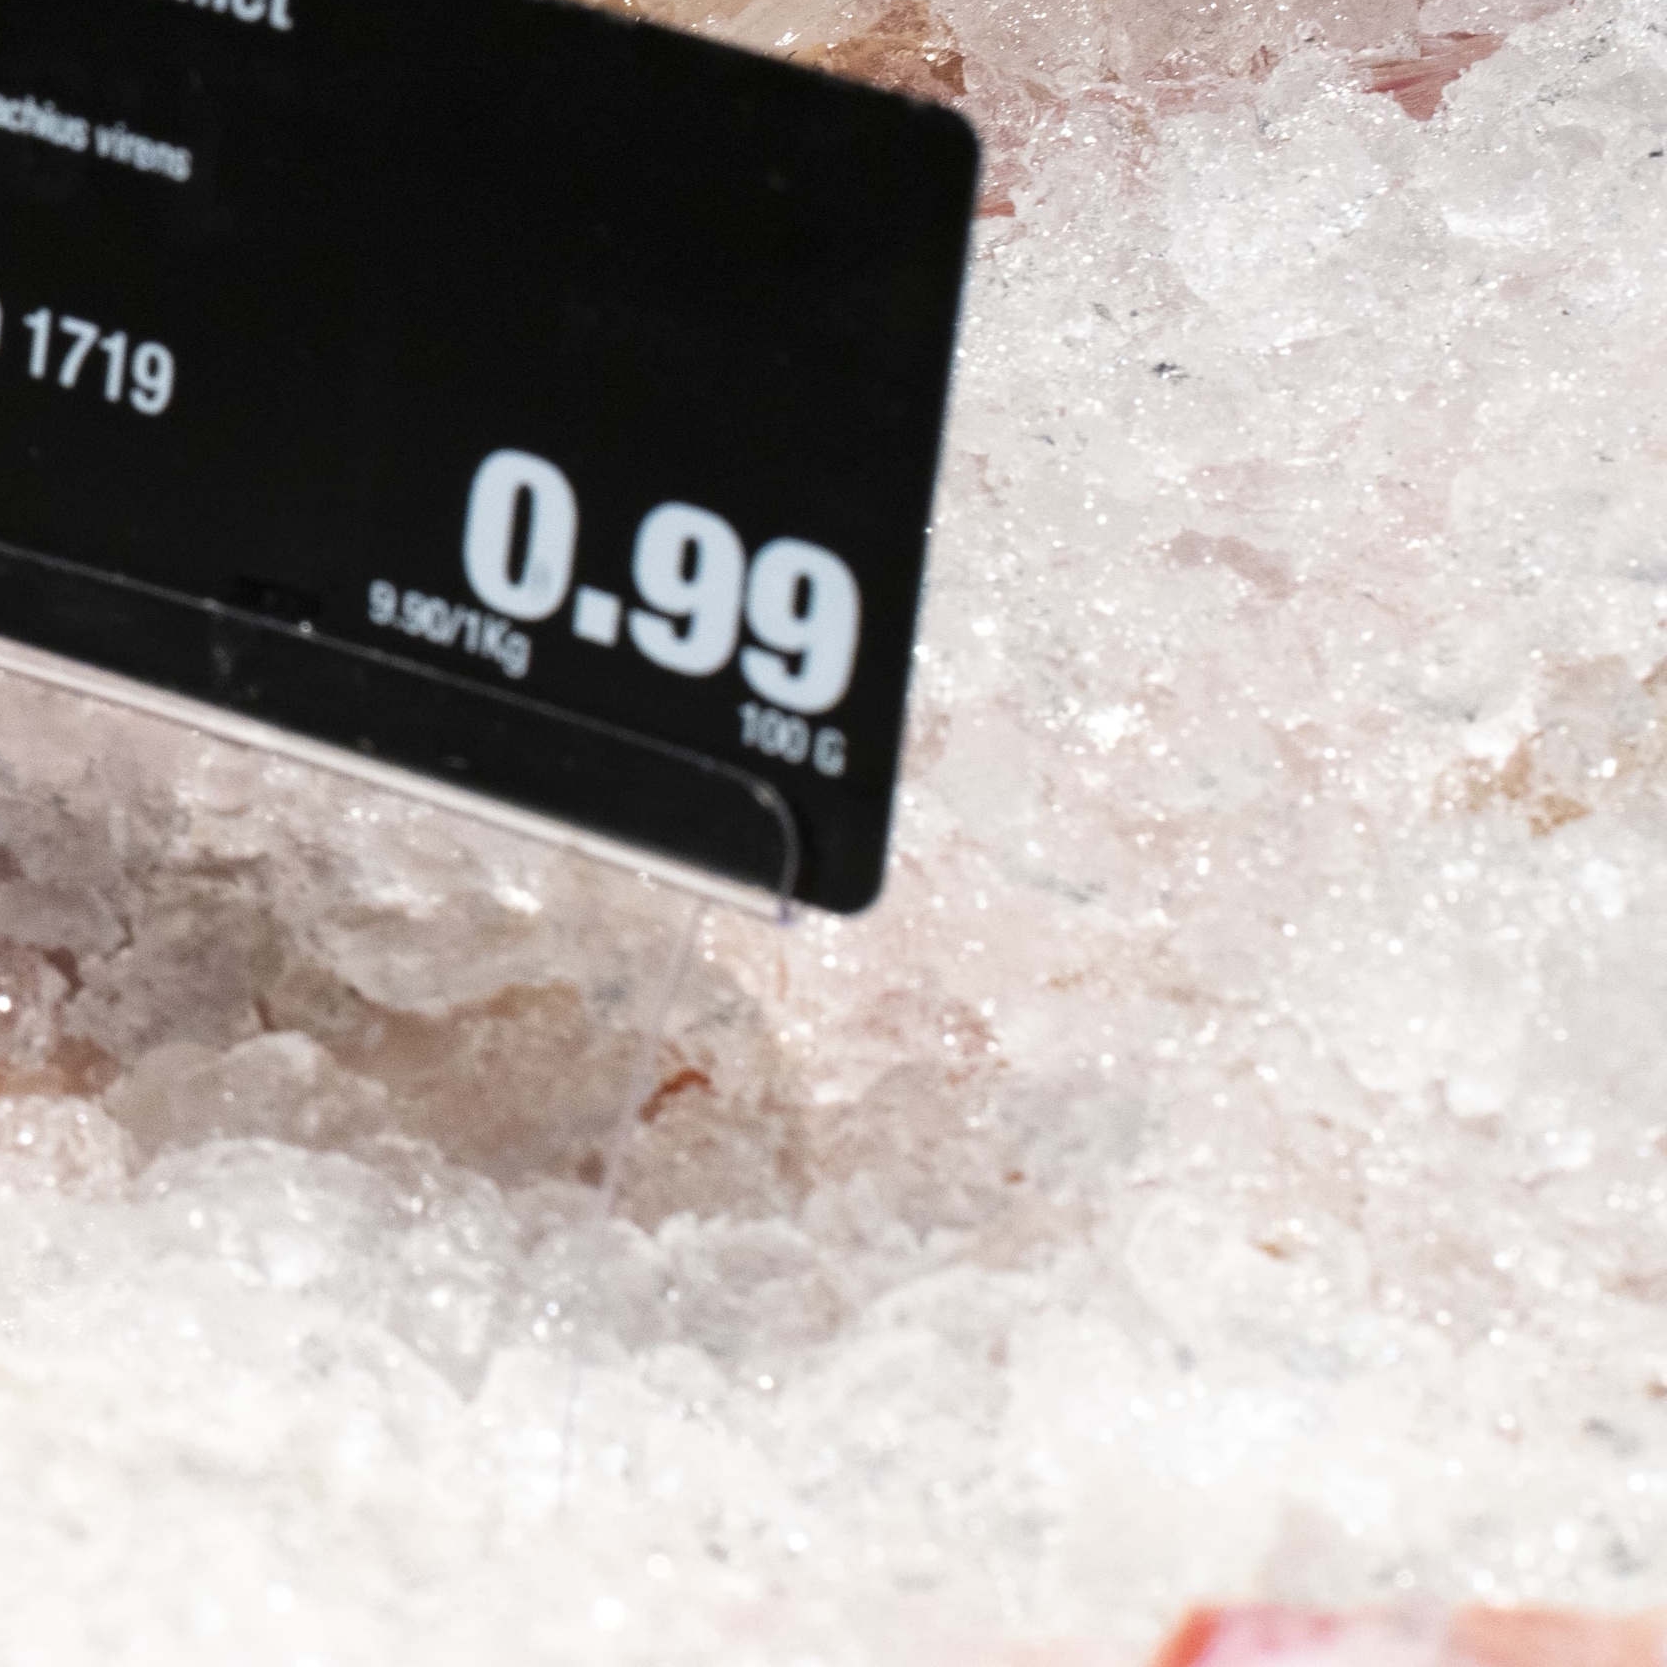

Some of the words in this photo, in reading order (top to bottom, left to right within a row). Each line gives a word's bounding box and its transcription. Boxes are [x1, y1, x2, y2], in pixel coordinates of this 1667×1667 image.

[93, 120, 193, 182] virens
[22, 306, 175, 416] 1719
[463, 447, 862, 715] 0.99
[737, 701, 809, 764] 100
[812, 725, 847, 777] G
